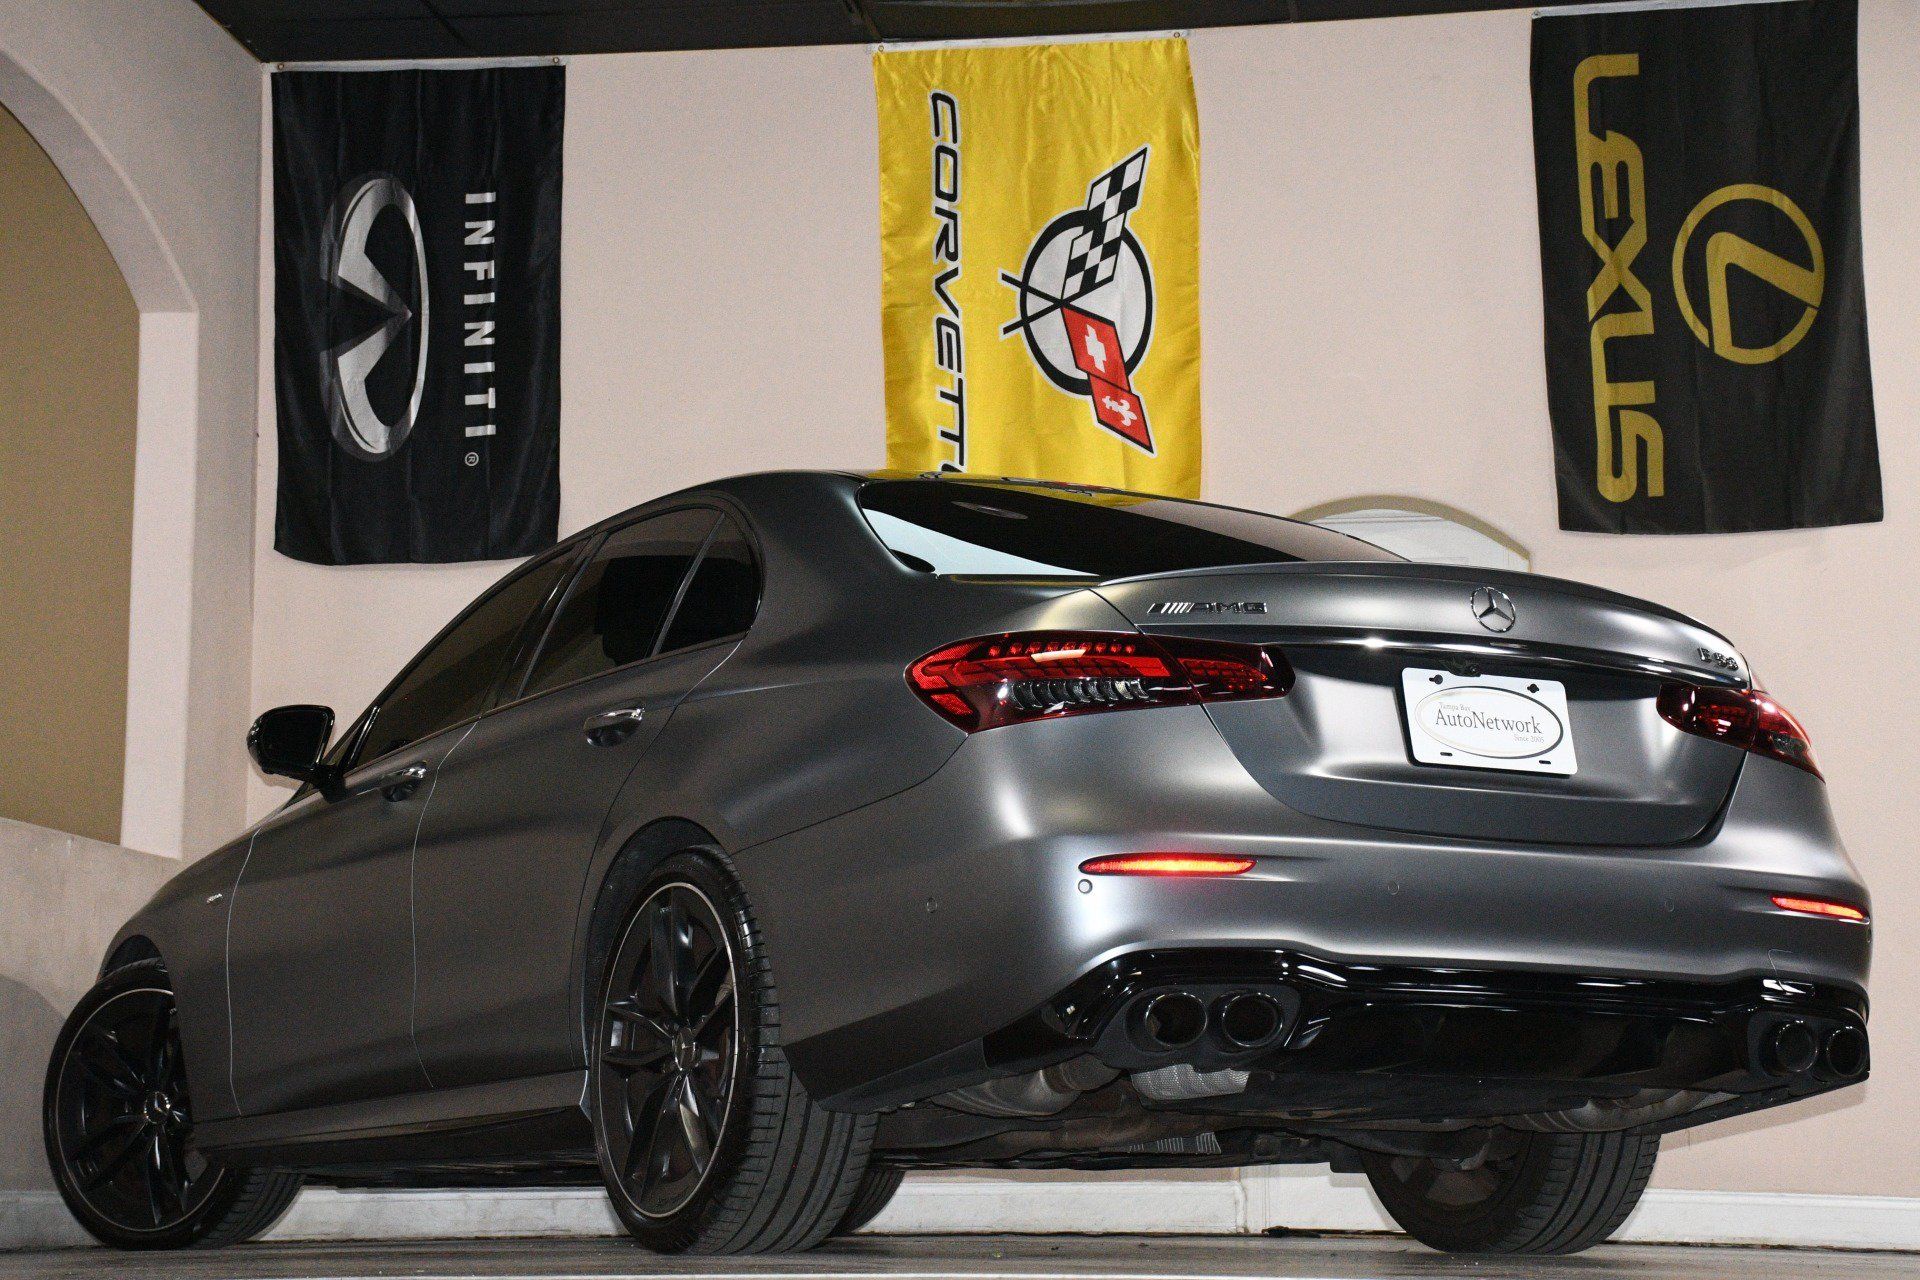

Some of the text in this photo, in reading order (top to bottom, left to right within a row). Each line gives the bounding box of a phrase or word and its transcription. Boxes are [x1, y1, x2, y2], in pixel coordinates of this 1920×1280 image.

[464, 192, 497, 438] INFINITI
[931, 91, 966, 472] CORVETT
[1573, 53, 1664, 503] LEXUS
[1435, 708, 1542, 734] AutoNetwork
